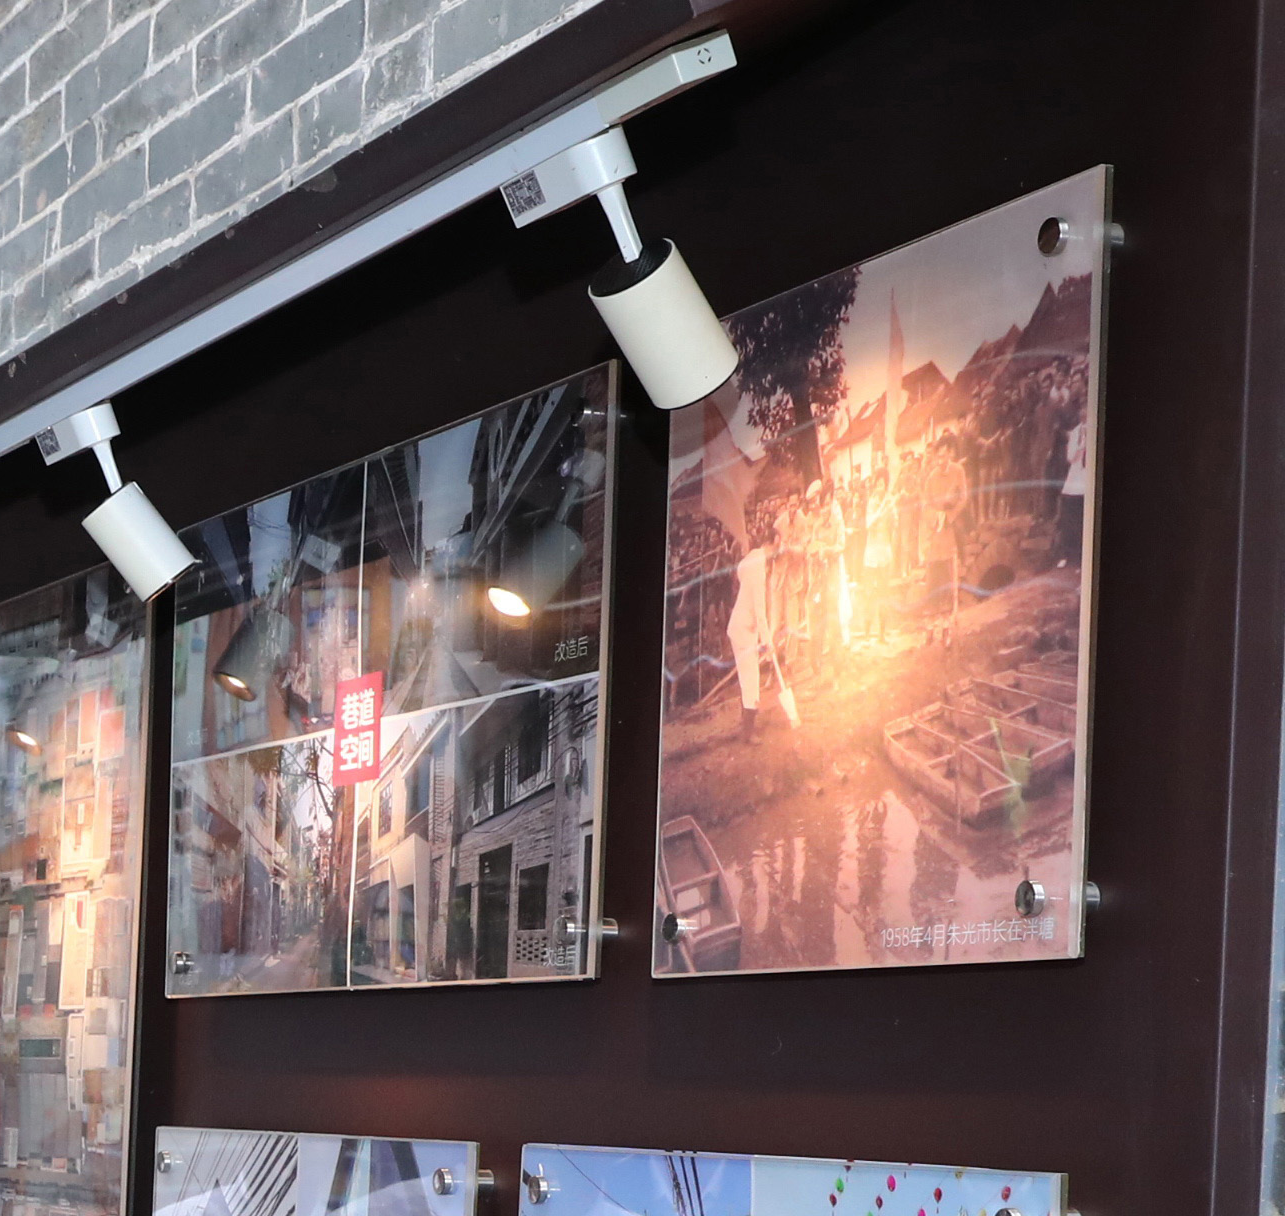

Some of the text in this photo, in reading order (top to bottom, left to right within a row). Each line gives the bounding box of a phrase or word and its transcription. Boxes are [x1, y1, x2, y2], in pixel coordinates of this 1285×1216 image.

[554, 635, 589, 662] 改造后
[341, 687, 375, 730] 巷道
[339, 730, 375, 771] 空间
